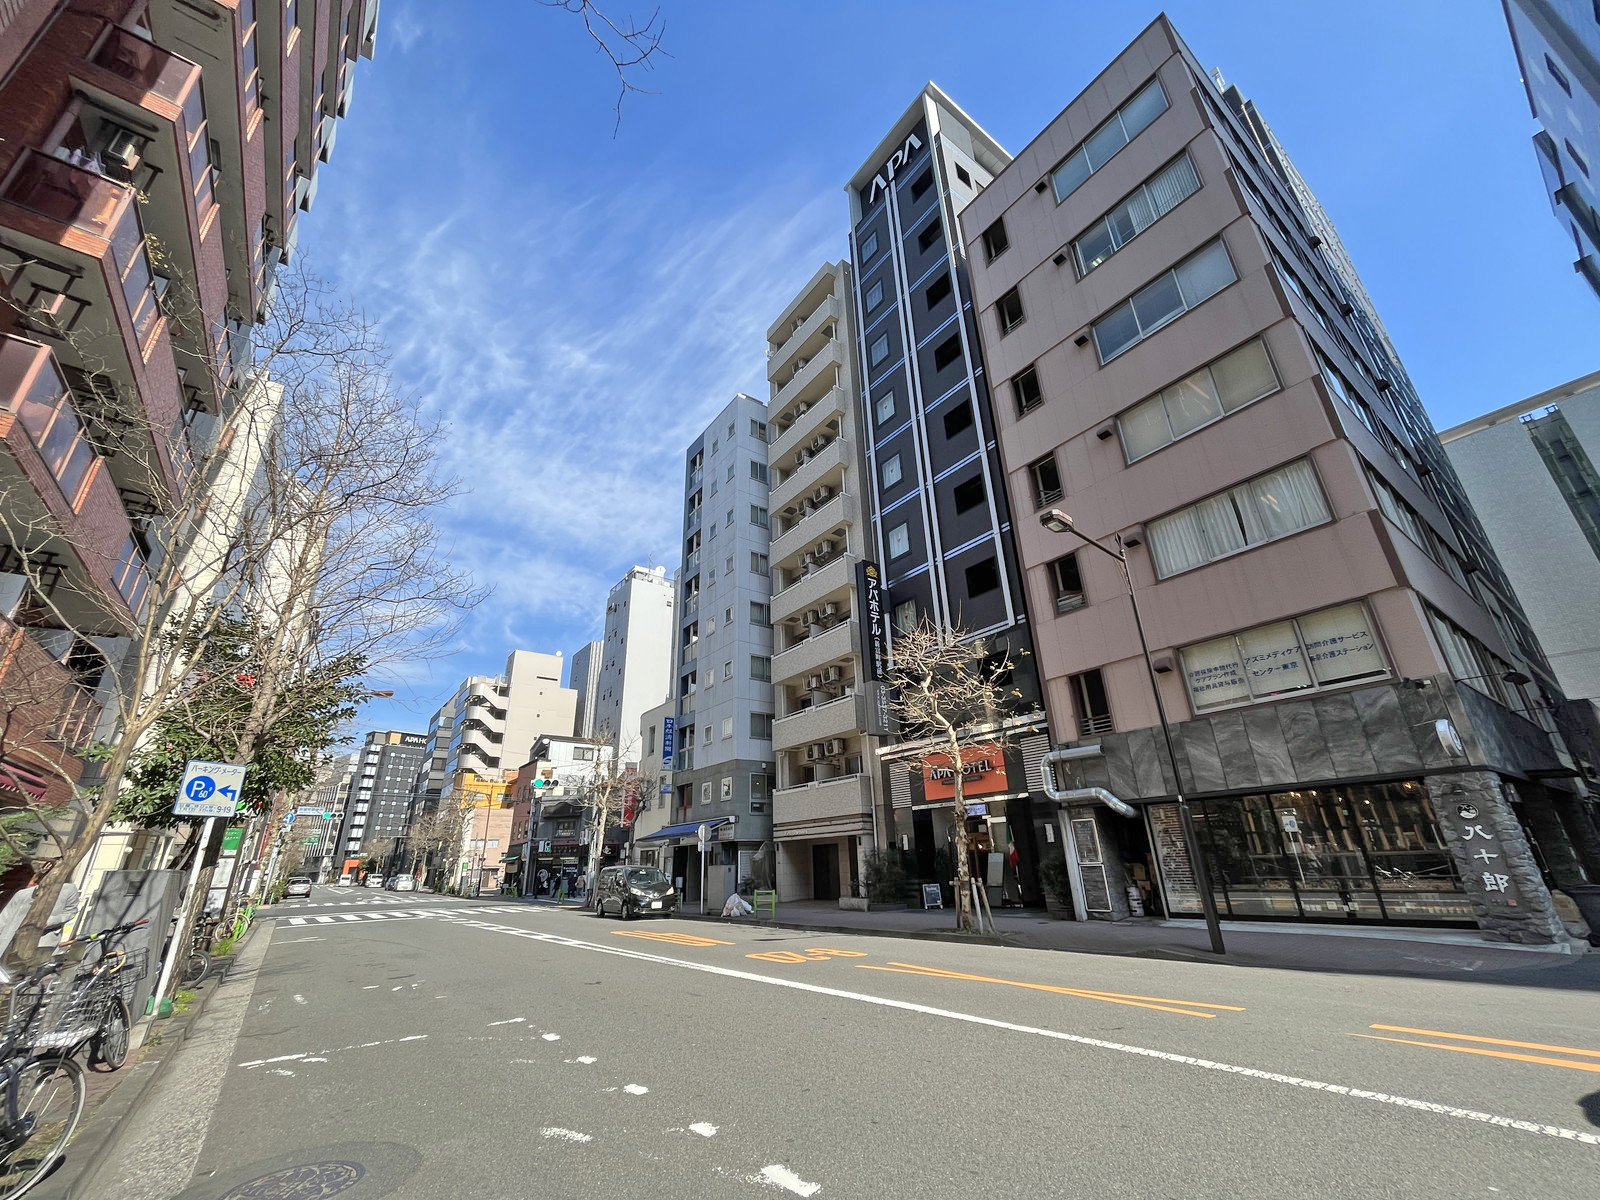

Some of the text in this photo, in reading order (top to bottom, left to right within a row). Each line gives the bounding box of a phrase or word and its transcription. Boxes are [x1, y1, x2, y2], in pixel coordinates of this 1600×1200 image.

[869, 133, 922, 204] APA
[867, 577, 882, 636] アパホテル
[1252, 661, 1299, 677] センター東京
[405, 736, 418, 744] APA
[1462, 824, 1509, 894] 八十郎
